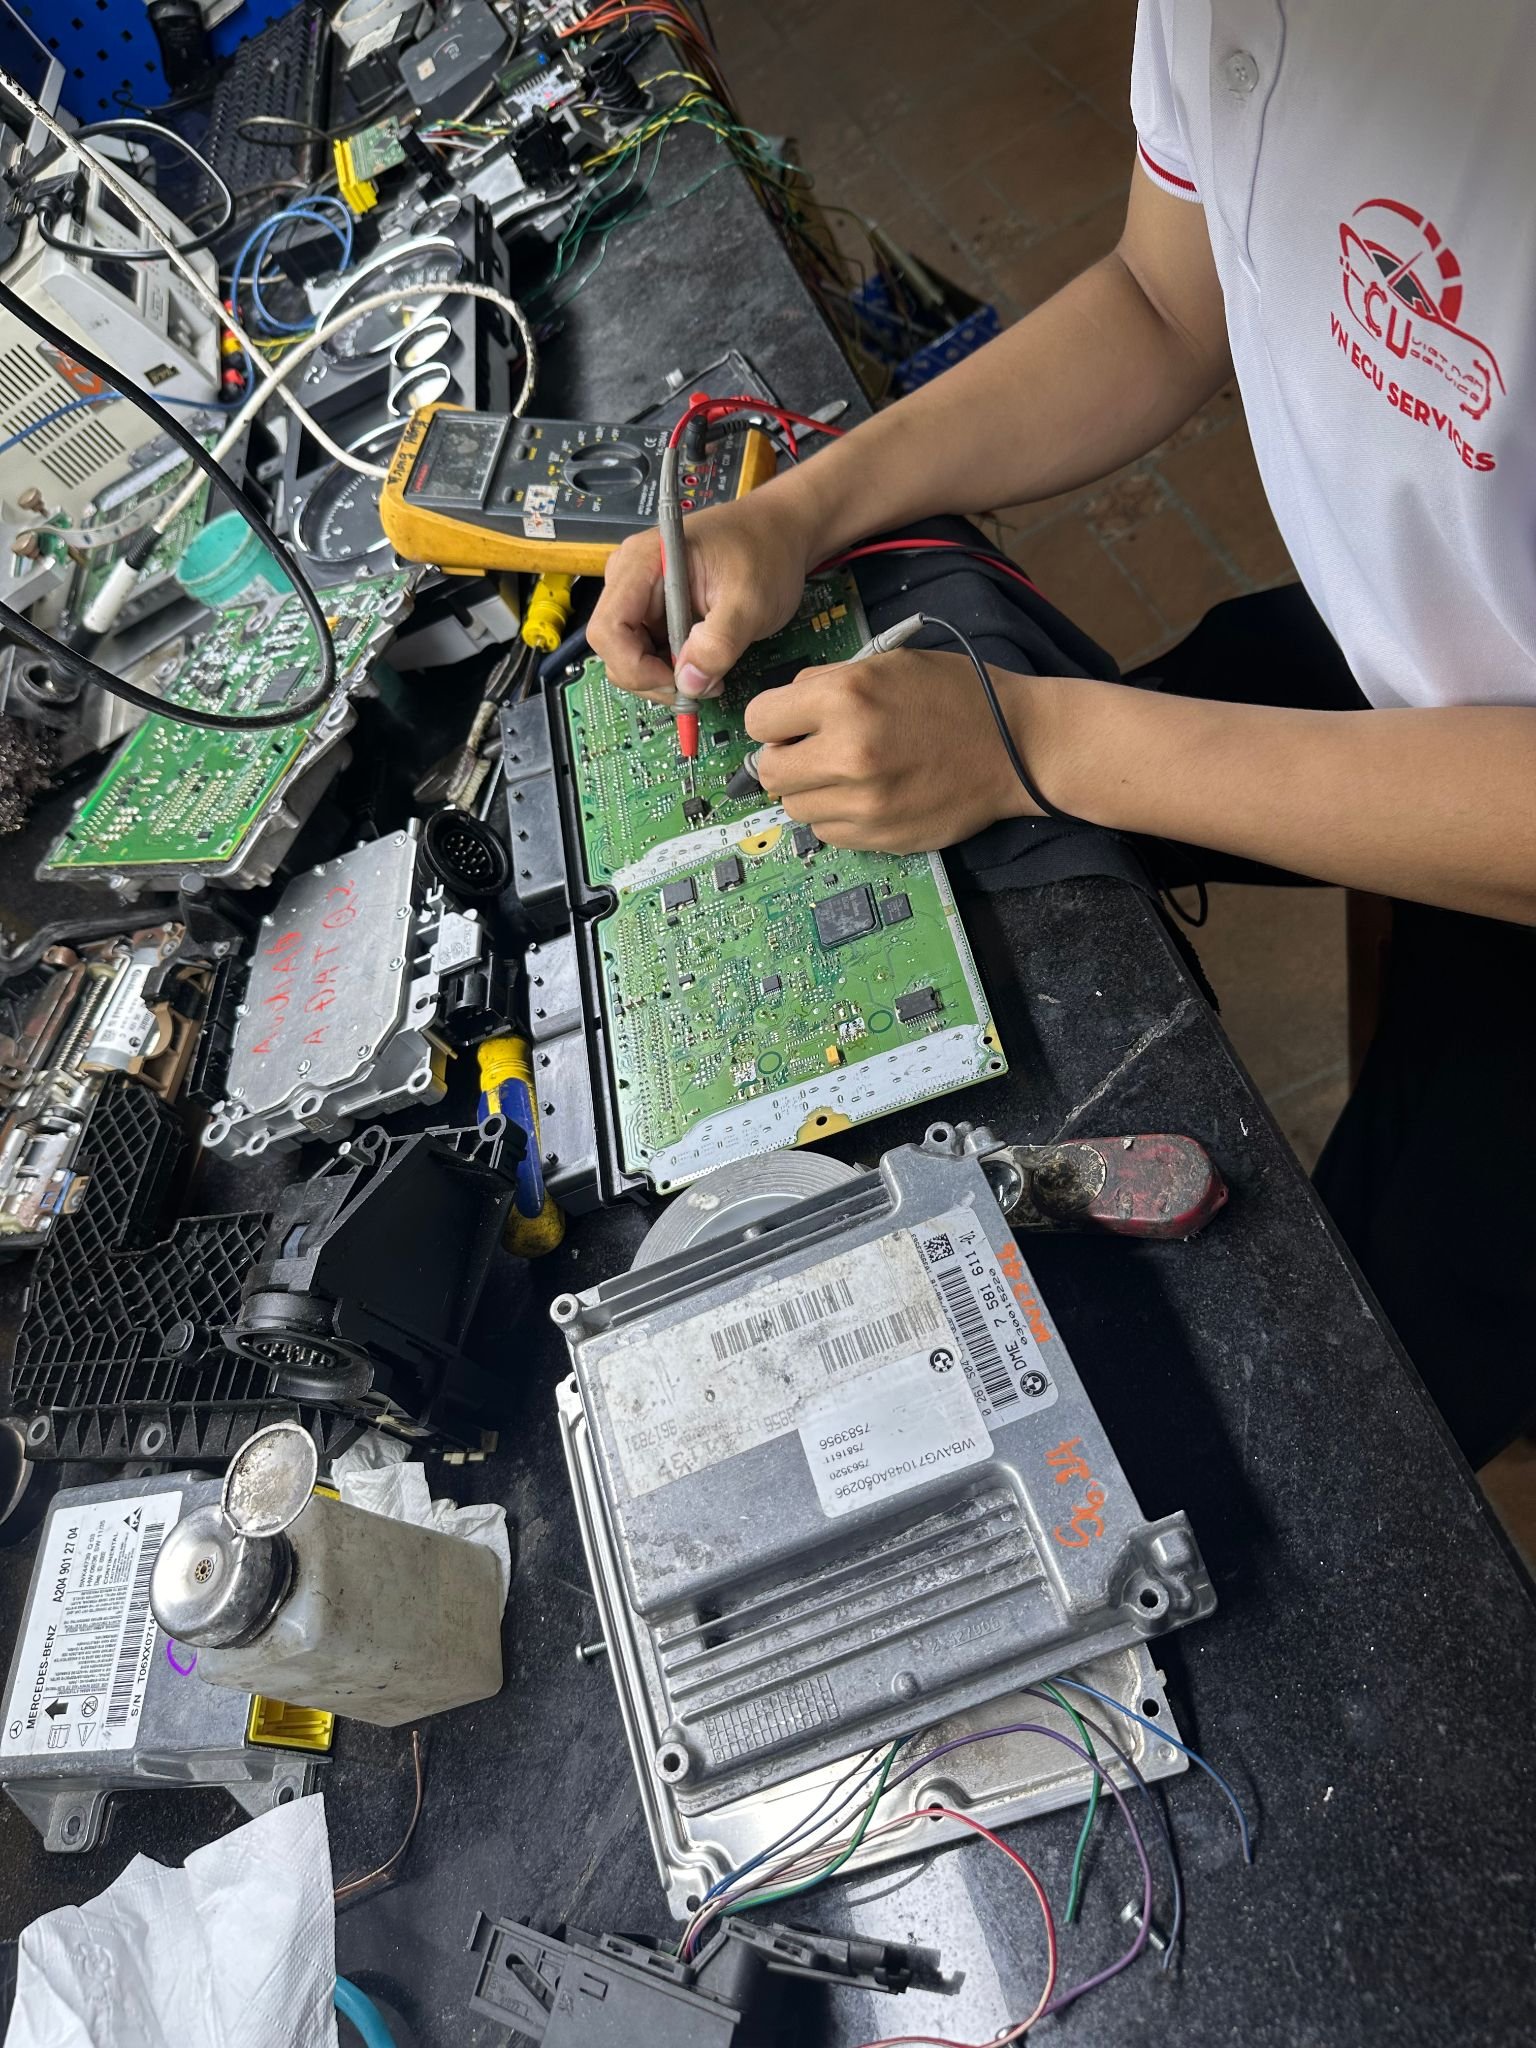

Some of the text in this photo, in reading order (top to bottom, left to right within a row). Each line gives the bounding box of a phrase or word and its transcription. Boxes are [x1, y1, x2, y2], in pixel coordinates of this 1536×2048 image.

[1330, 312, 1496, 472] VN ECU SERVICES
[965, 1250, 984, 1275] 611
[979, 1283, 999, 1310] 581
[994, 1315, 1007, 1327] 7
[1004, 1341, 1027, 1370] DME
[818, 1422, 870, 1449] 7583956
[824, 1442, 864, 1463] 7581611
[828, 1457, 870, 1479] 7563520
[103, 1532, 118, 1584] CONTINENTAL
[26, 1526, 79, 1729] MERCEDES-BENZ A204 901 27 04
[130, 1614, 157, 1717] S/N T06XX0714
